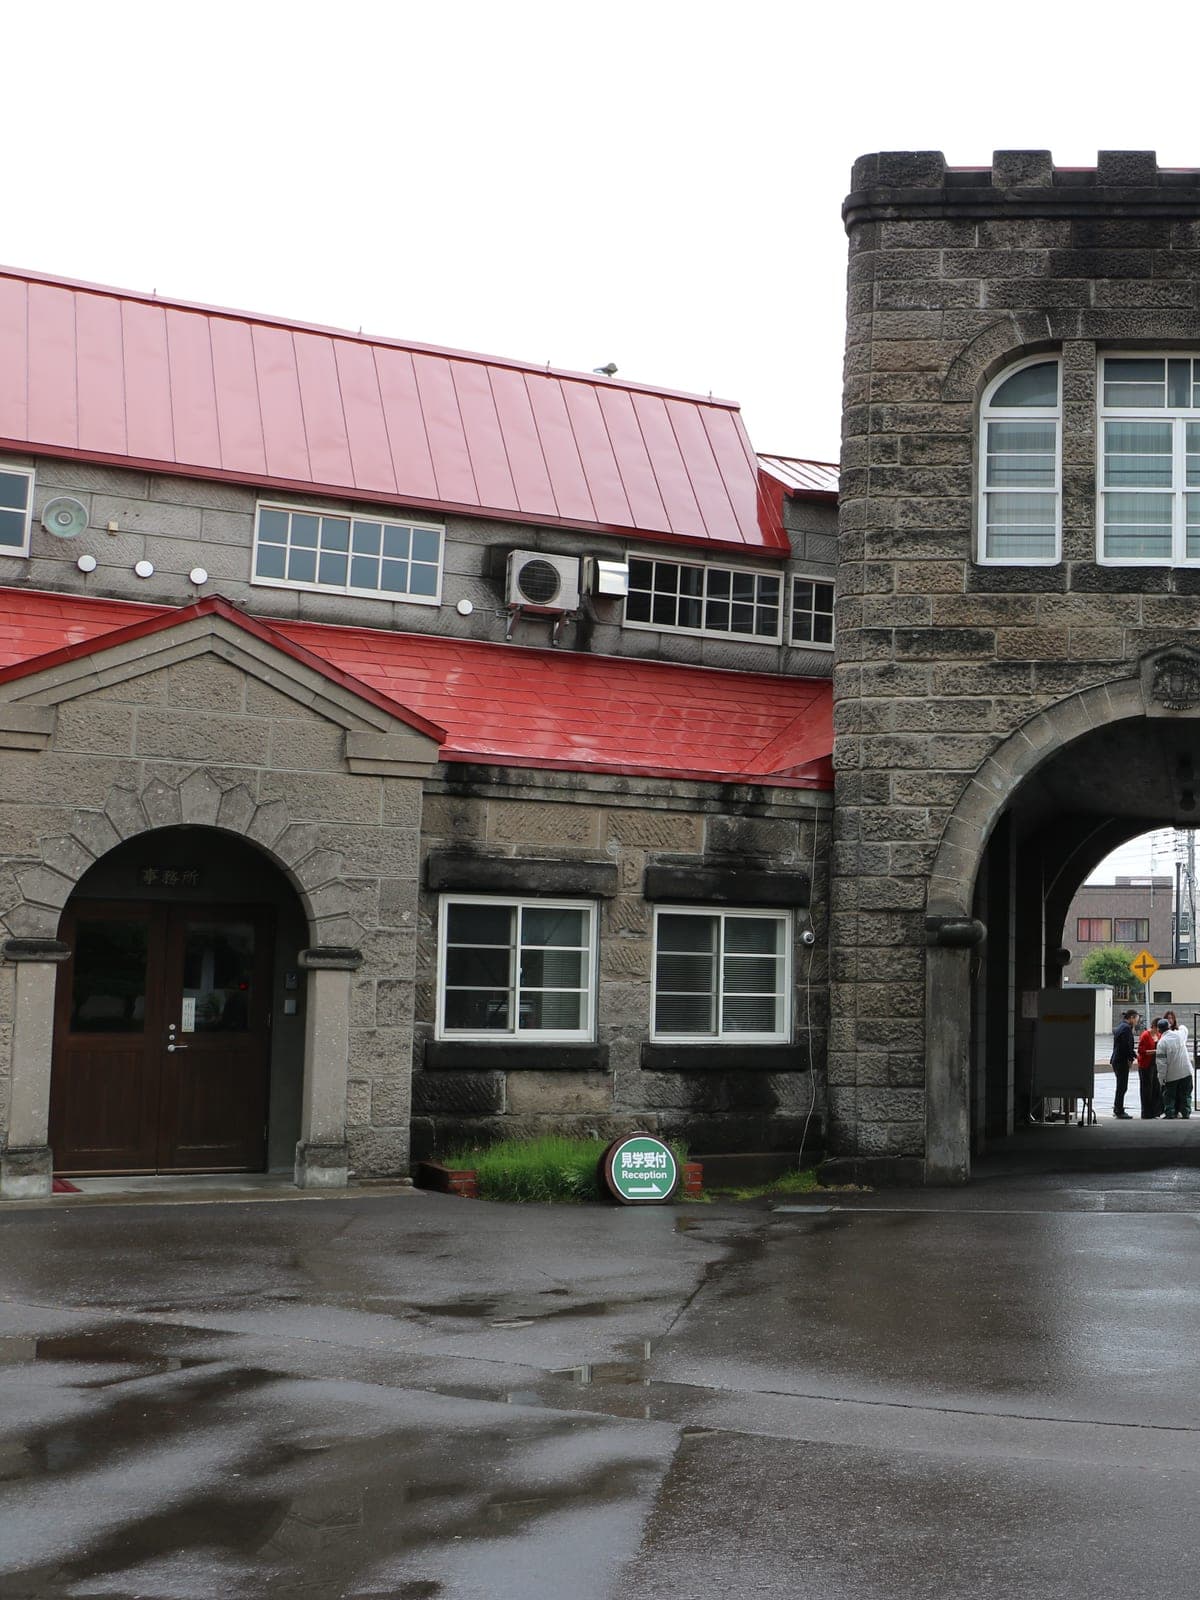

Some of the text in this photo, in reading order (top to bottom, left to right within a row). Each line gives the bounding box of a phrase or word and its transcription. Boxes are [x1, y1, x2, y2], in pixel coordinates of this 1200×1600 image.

[621, 1152, 667, 1168] 見学受付
[622, 1170, 667, 1180] Reception
